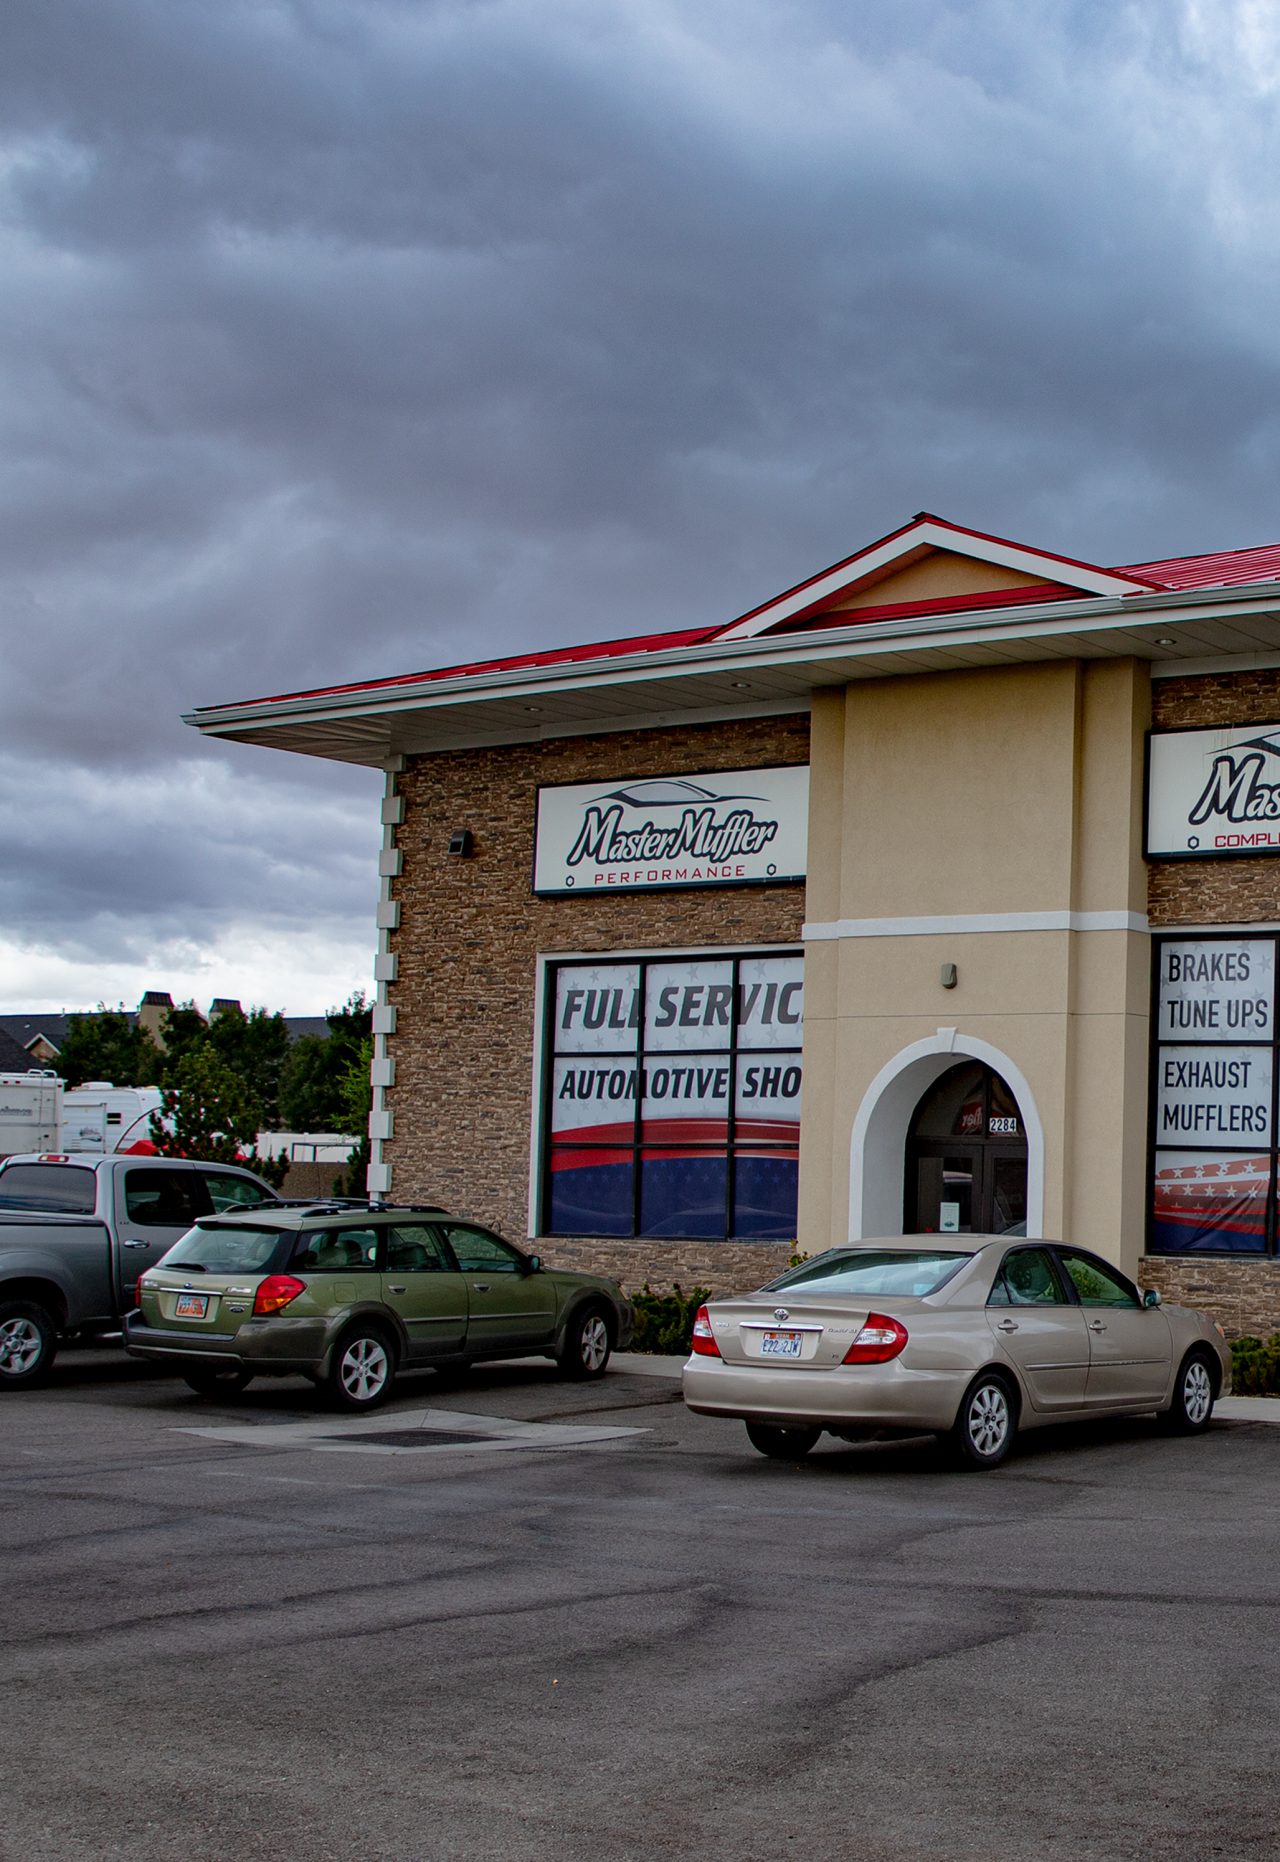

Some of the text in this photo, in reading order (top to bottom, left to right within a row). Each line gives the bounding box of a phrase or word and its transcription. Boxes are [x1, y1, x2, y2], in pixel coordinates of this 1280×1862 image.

[594, 865, 746, 886] PERFORMANCE
[1168, 952, 1251, 982] BRAKES
[561, 981, 804, 1029] FULL SERVIC
[1167, 998, 1268, 1029] TUNE UPS
[559, 1066, 803, 1100] AUTOMOTIVE SHO
[1164, 1061, 1252, 1089] EXHAUST
[990, 1118, 1016, 1132] 2284
[1163, 1105, 1268, 1132] MUFFLERS
[762, 1339, 778, 1353] E22
